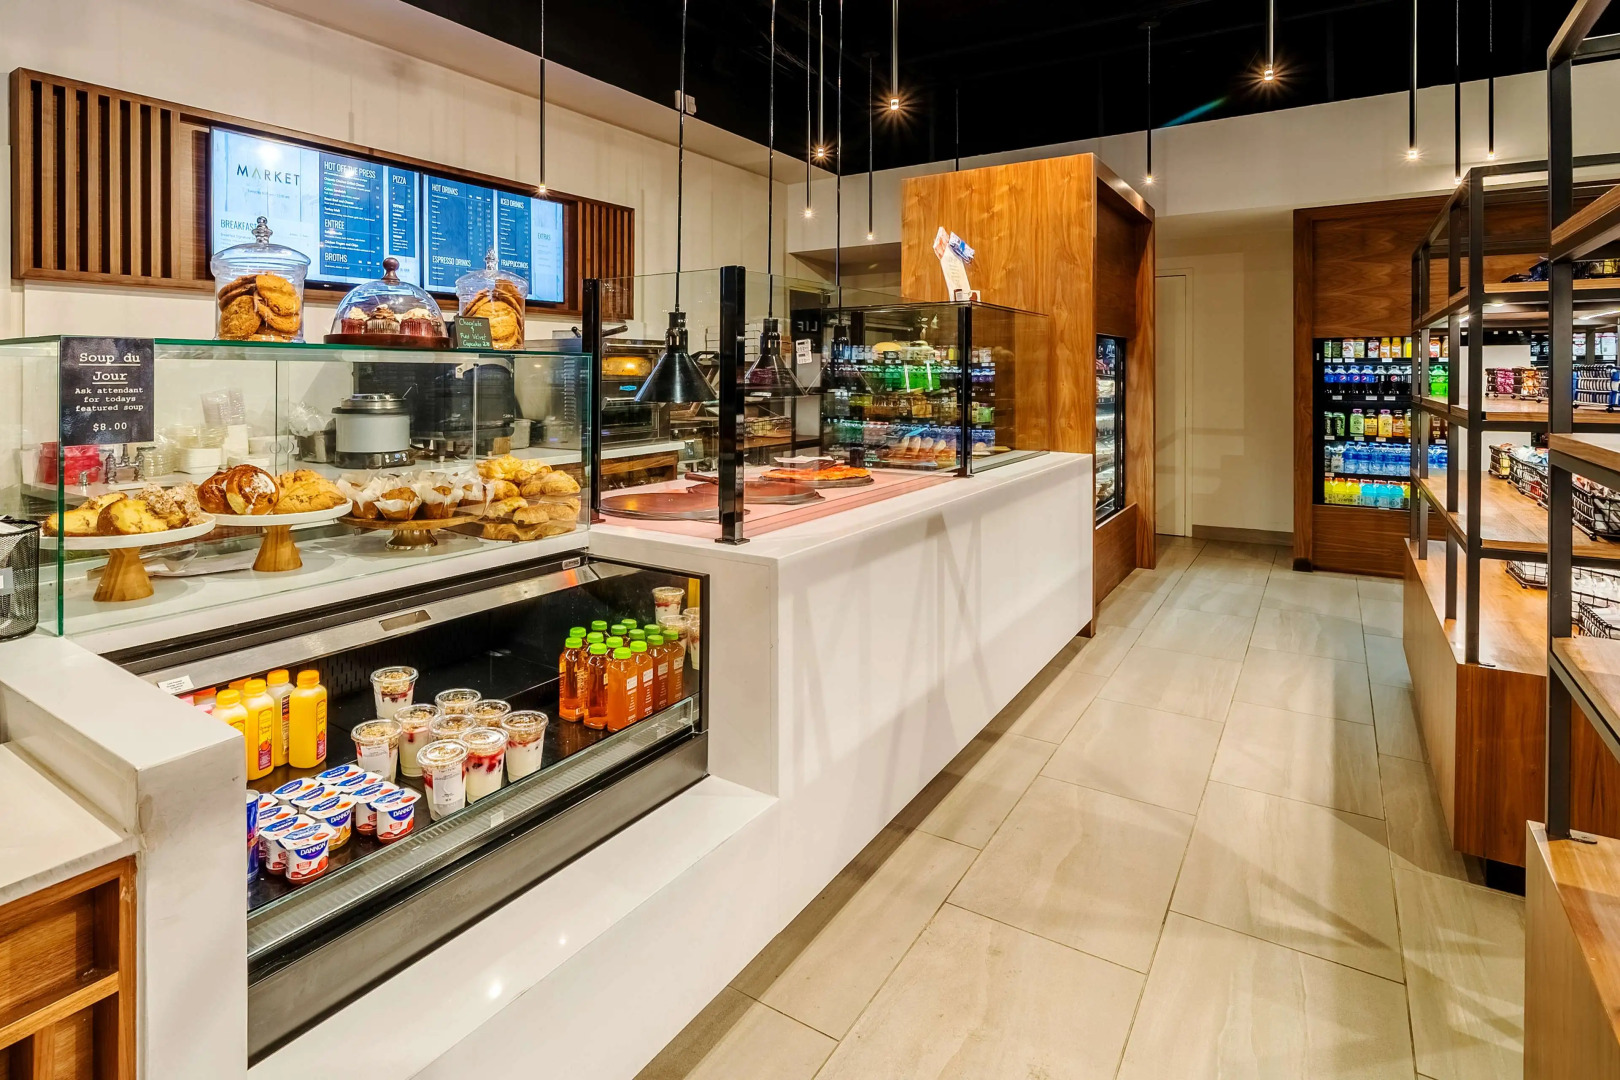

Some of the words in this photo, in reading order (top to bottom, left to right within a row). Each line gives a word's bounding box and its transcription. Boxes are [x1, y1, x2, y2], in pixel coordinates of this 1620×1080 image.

[237, 164, 300, 186] MARKET
[324, 161, 336, 171] HOT
[359, 168, 376, 179] PRESS
[393, 174, 406, 185] PIZZA
[432, 183, 441, 193] HOT
[325, 252, 348, 262] BROTHS
[432, 256, 454, 265] ESPRESSO
[79, 353, 114, 365] Soup
[123, 353, 140, 363] du
[92, 371, 128, 381] Jour
[93, 422, 127, 432] $8.00
[300, 841, 325, 856] DANNON
